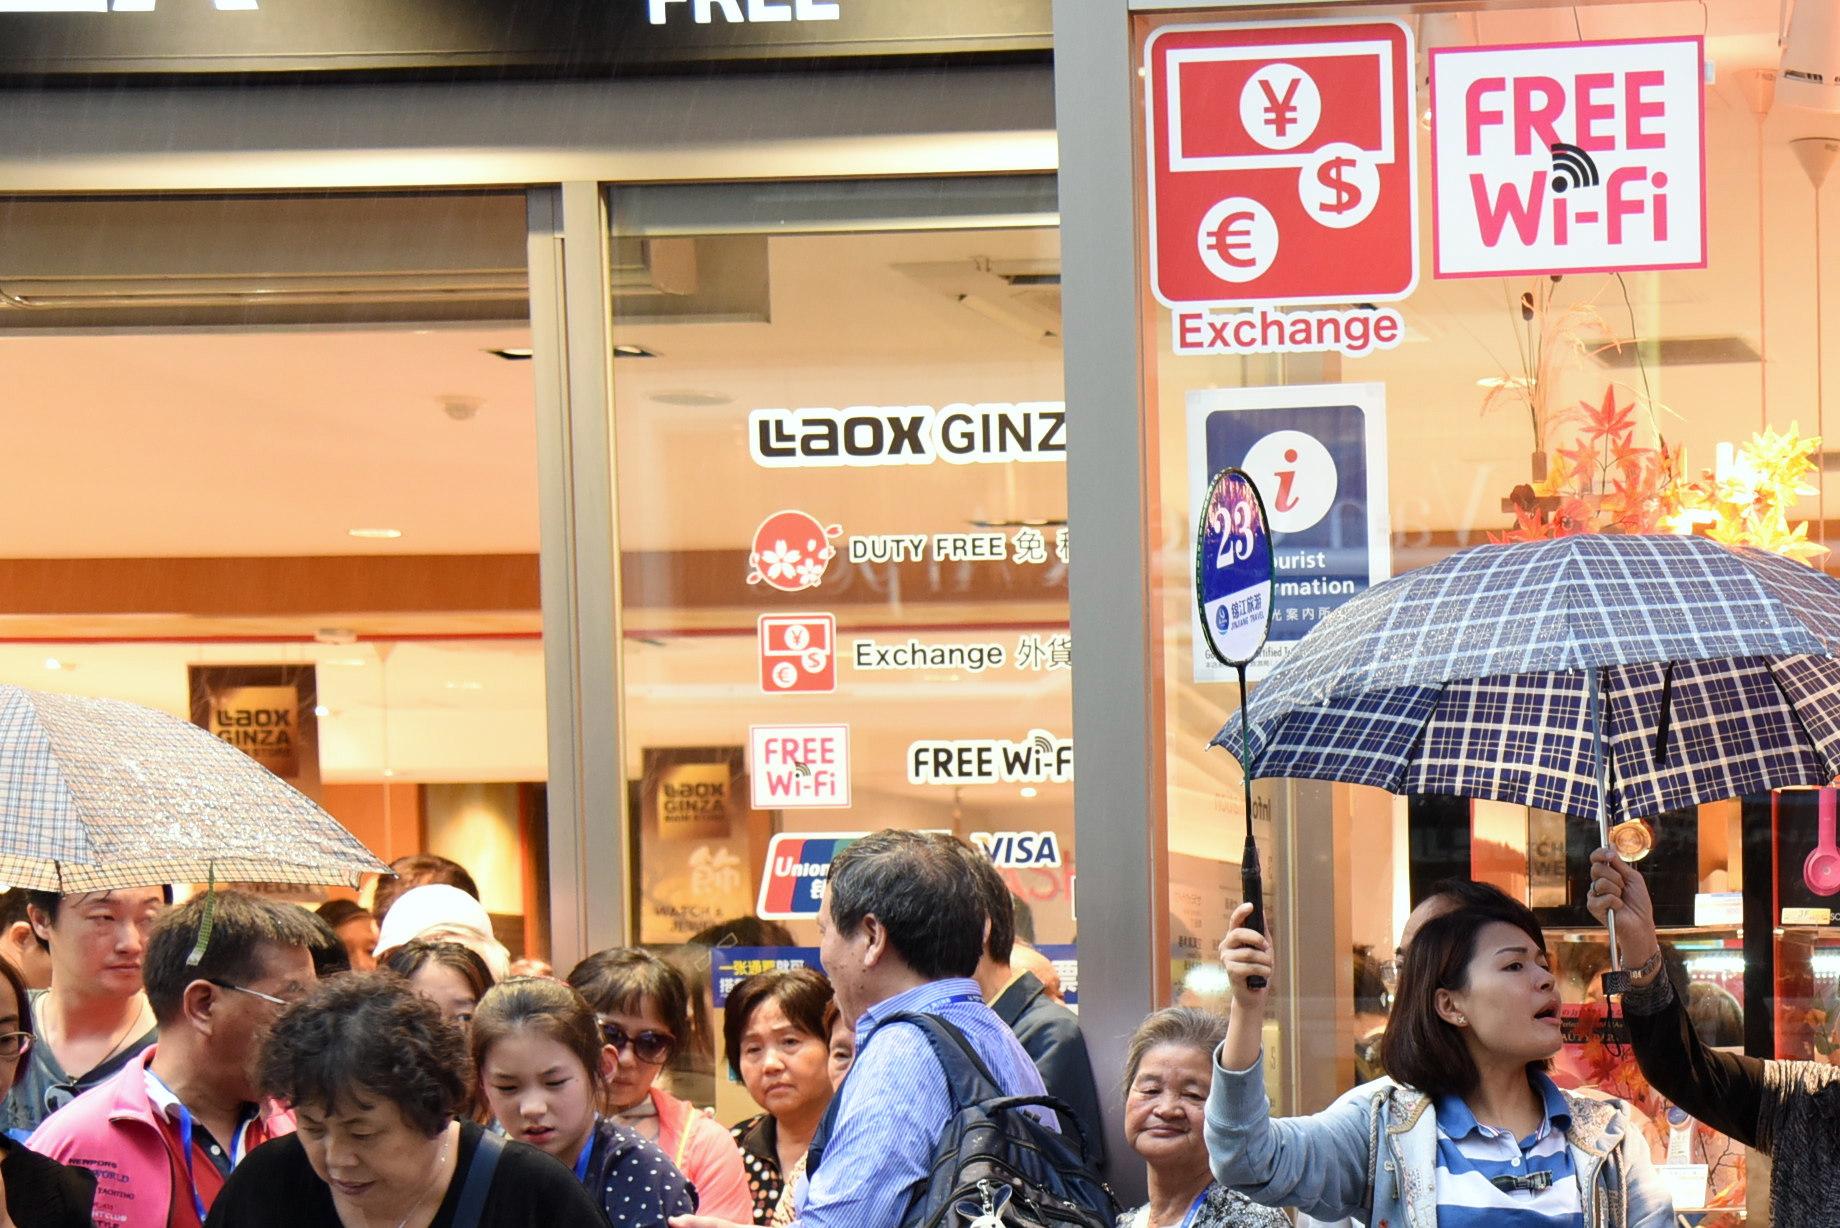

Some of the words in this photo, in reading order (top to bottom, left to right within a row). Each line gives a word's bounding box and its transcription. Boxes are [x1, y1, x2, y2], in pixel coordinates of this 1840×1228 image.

[1465, 70, 1665, 156] FREE
[1470, 167, 1669, 247] Wi-Fi
[1179, 310, 1399, 351] Exchange
[941, 412, 1066, 454] GINZ
[853, 539, 923, 559] DUTY
[937, 537, 1003, 557] FREE
[1215, 501, 1254, 569] 23
[1274, 551, 1326, 569] ourist
[1275, 577, 1354, 596] rmation
[1272, 606, 1331, 622] 光案内所
[856, 643, 1003, 670] Exchange
[218, 730, 290, 746] GINZA
[765, 738, 834, 765] FREE
[914, 747, 992, 778] FREE
[1002, 745, 1072, 777] Wi-F
[767, 770, 835, 797] Wi-Fi
[982, 836, 1056, 863] VISA
